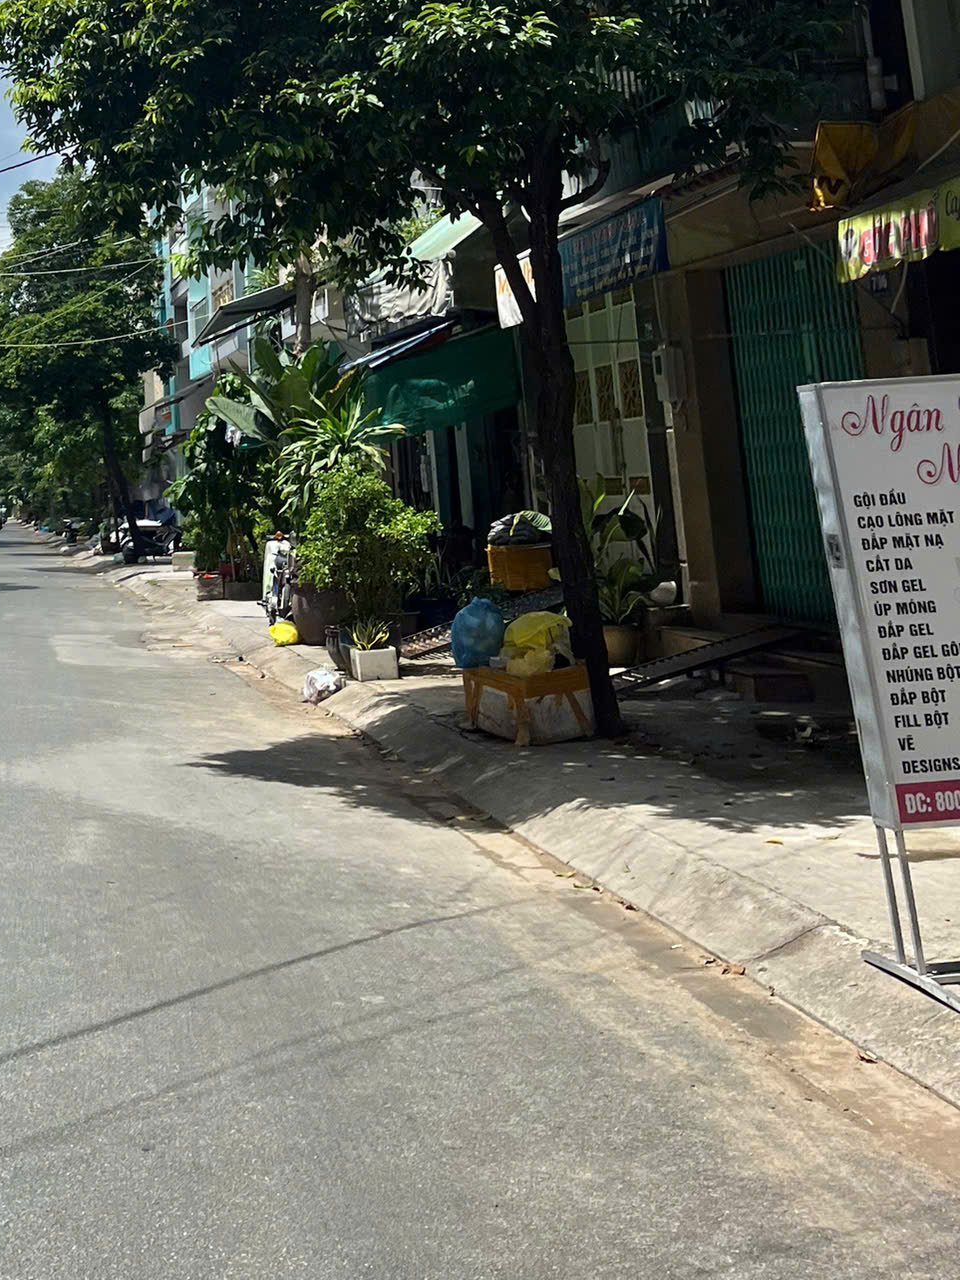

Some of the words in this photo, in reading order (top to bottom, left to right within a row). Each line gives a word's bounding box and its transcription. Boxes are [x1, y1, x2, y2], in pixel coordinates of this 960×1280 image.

[841, 394, 944, 452] Ngân
[853, 491, 876, 510] GỘI
[857, 515, 884, 531] CẠO
[888, 511, 923, 527] LÔNG
[926, 509, 954, 527] MẶT
[892, 533, 920, 550] MẶT
[924, 534, 944, 549] NẠ
[894, 557, 913, 570] DA
[870, 579, 898, 594] SƠN
[901, 578, 927, 592] GEL
[874, 600, 891, 616] ÚP
[896, 598, 937, 615] MÓNG
[909, 623, 934, 636] GEL
[913, 645, 938, 658] GEL
[886, 665, 933, 683] NHÚNG
[936, 663, 960, 682] BỘT
[921, 687, 946, 706] BỘT
[894, 714, 921, 728] FILL
[924, 710, 949, 728] BỘT
[897, 734, 915, 751] VẼ
[902, 757, 960, 774] DESIGNS
[904, 793, 932, 814] ĐC:
